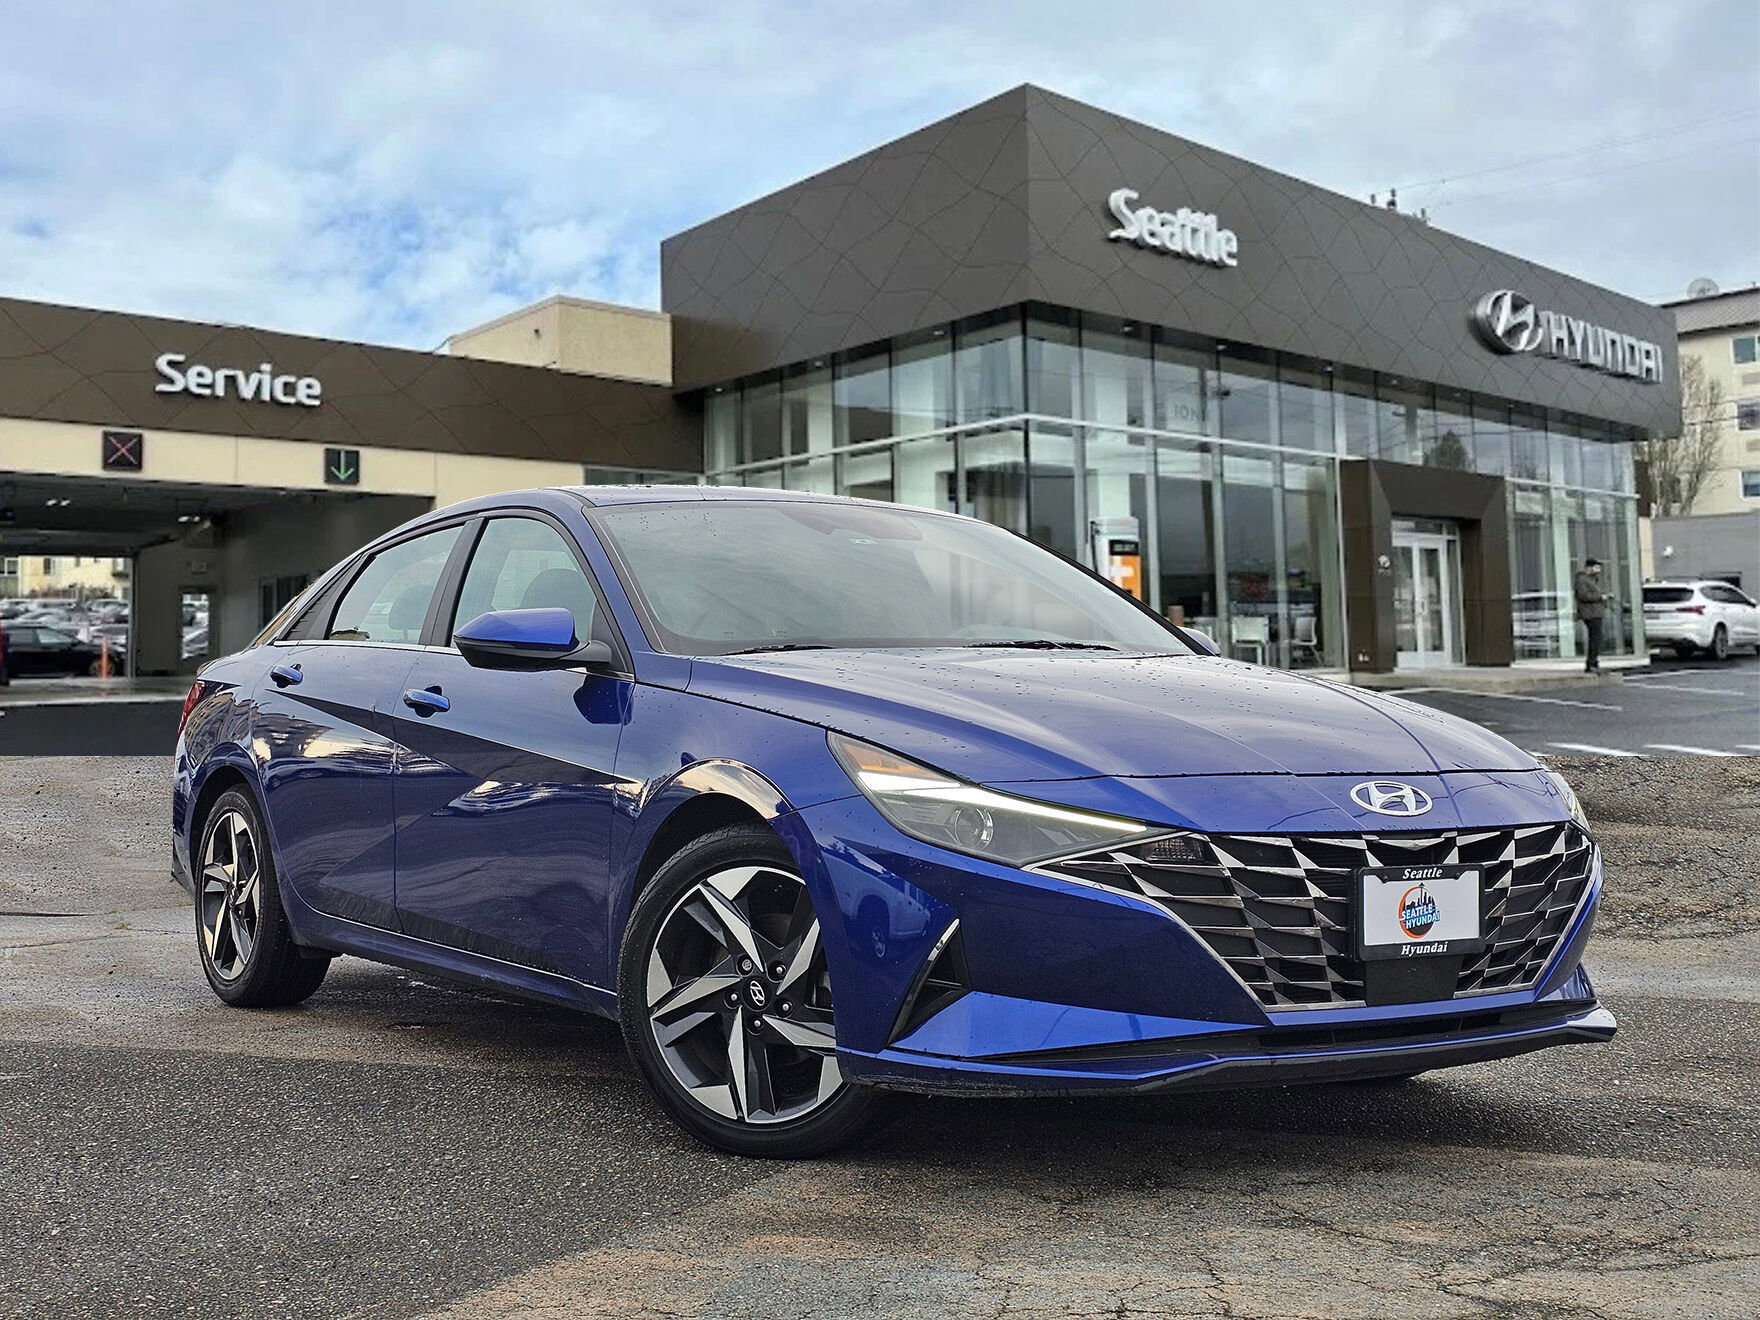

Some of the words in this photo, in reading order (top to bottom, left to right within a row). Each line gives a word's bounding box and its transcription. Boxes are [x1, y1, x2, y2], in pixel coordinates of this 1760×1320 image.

[1109, 188, 1238, 266] Seattle
[1543, 311, 1663, 383] HYUNDAI
[155, 353, 321, 405] Service
[1402, 867, 1443, 879] Seattle
[1401, 903, 1433, 920] SEATTLE
[1405, 909, 1440, 929] HYUNDAI
[1401, 942, 1448, 957] Hyundai
